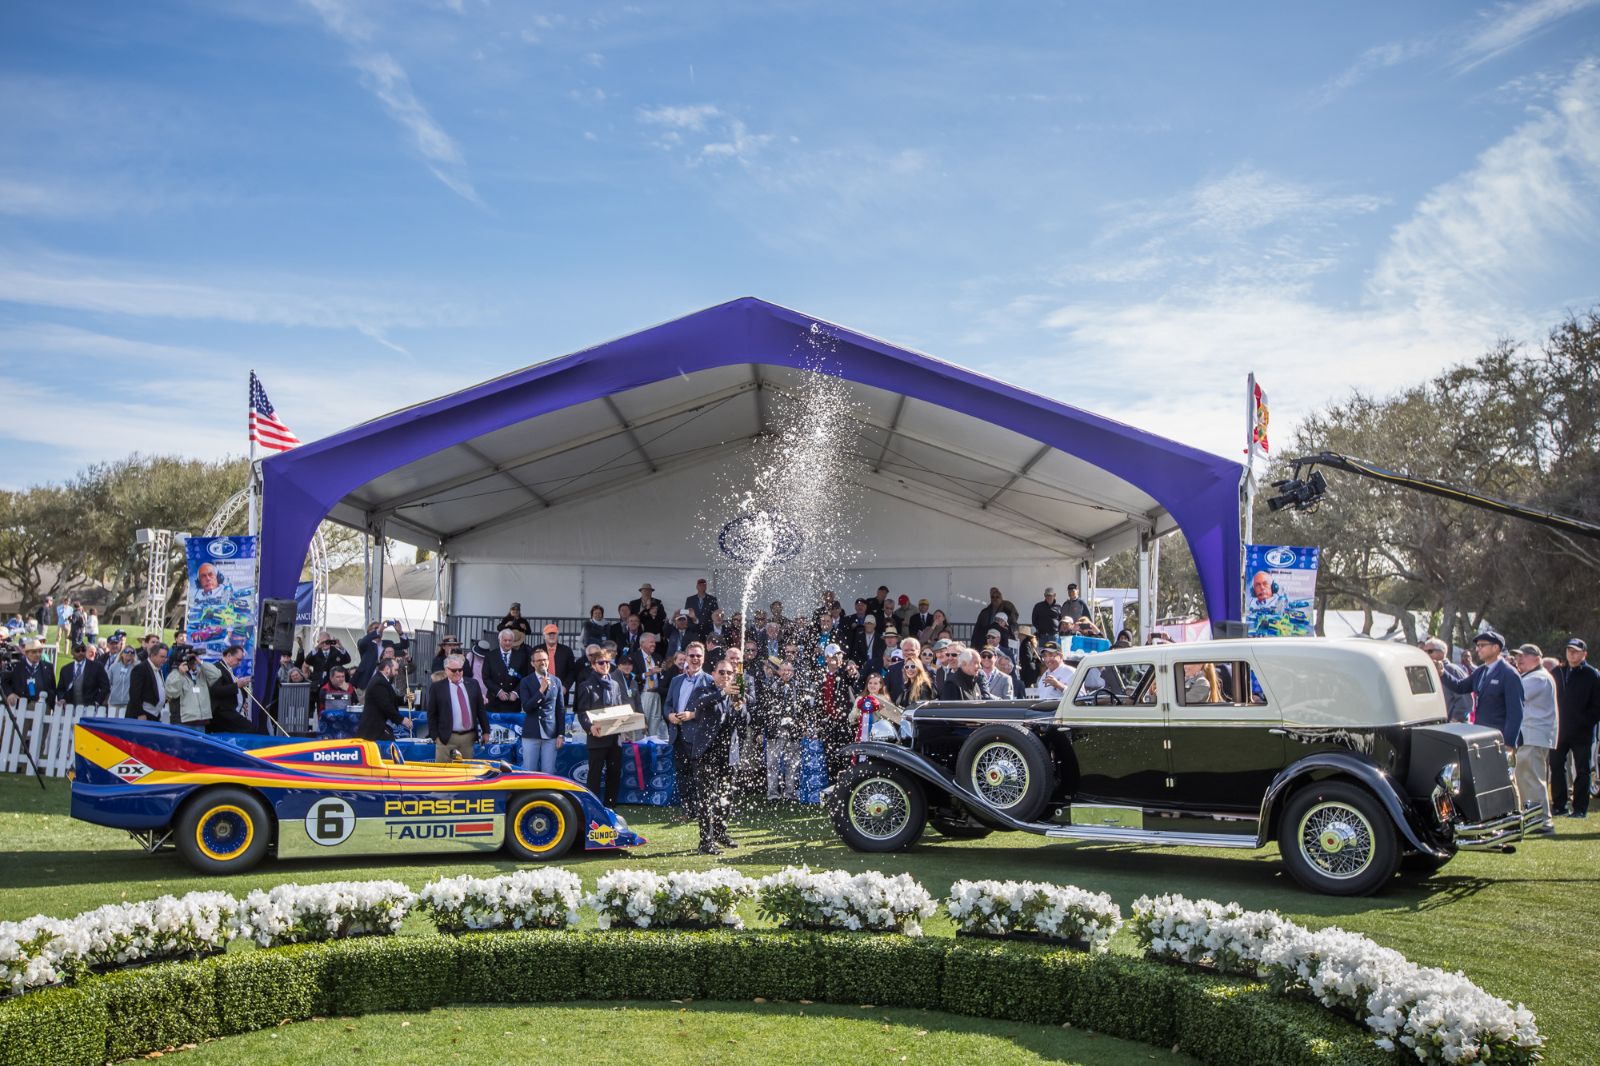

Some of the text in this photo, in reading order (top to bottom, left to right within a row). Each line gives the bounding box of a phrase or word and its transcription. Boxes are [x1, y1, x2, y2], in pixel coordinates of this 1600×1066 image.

[313, 750, 359, 762] DieHard
[117, 766, 144, 775] DX
[384, 798, 495, 816] PORSCHE
[316, 803, 345, 839] 6
[589, 830, 618, 840] SUNOCO
